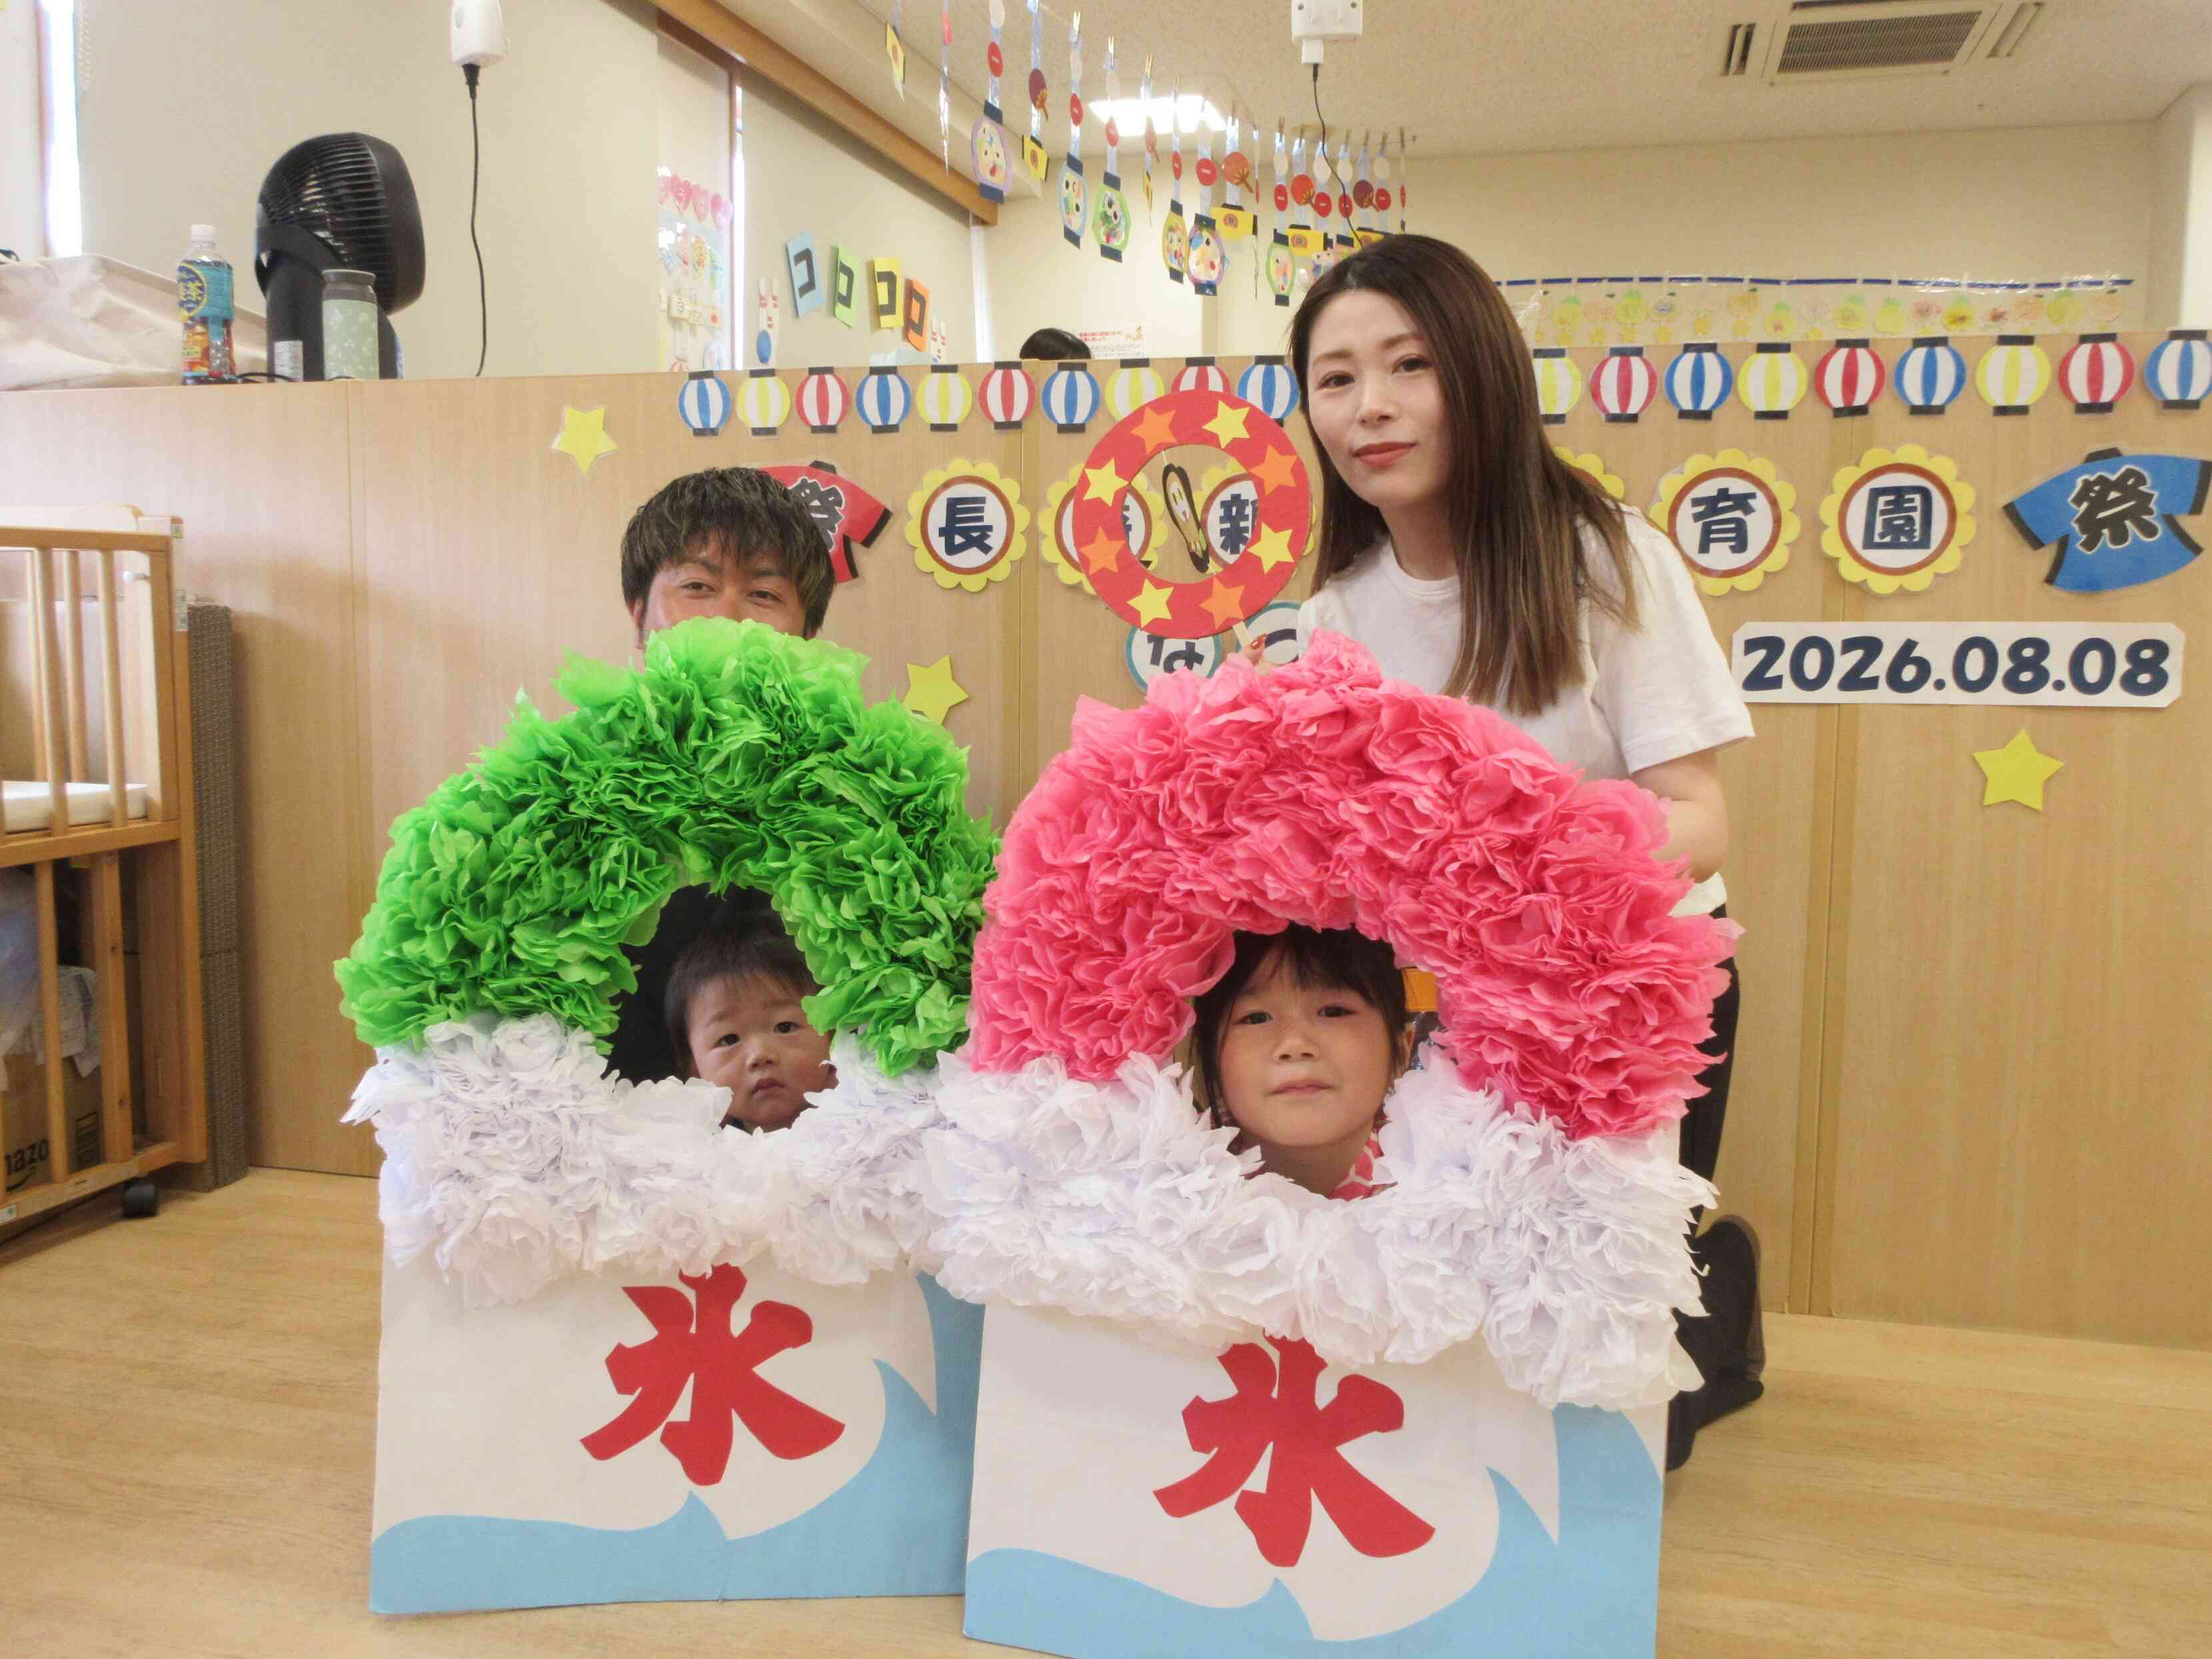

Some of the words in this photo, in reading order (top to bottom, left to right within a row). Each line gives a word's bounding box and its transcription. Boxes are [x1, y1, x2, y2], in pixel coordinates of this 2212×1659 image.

[938, 496, 994, 556] 長
[2074, 466, 2161, 553] 祭
[1741, 635, 2170, 697] 2026.08.08
[579, 1262, 846, 1486] 氷
[1152, 1326, 1436, 1568] 氷
